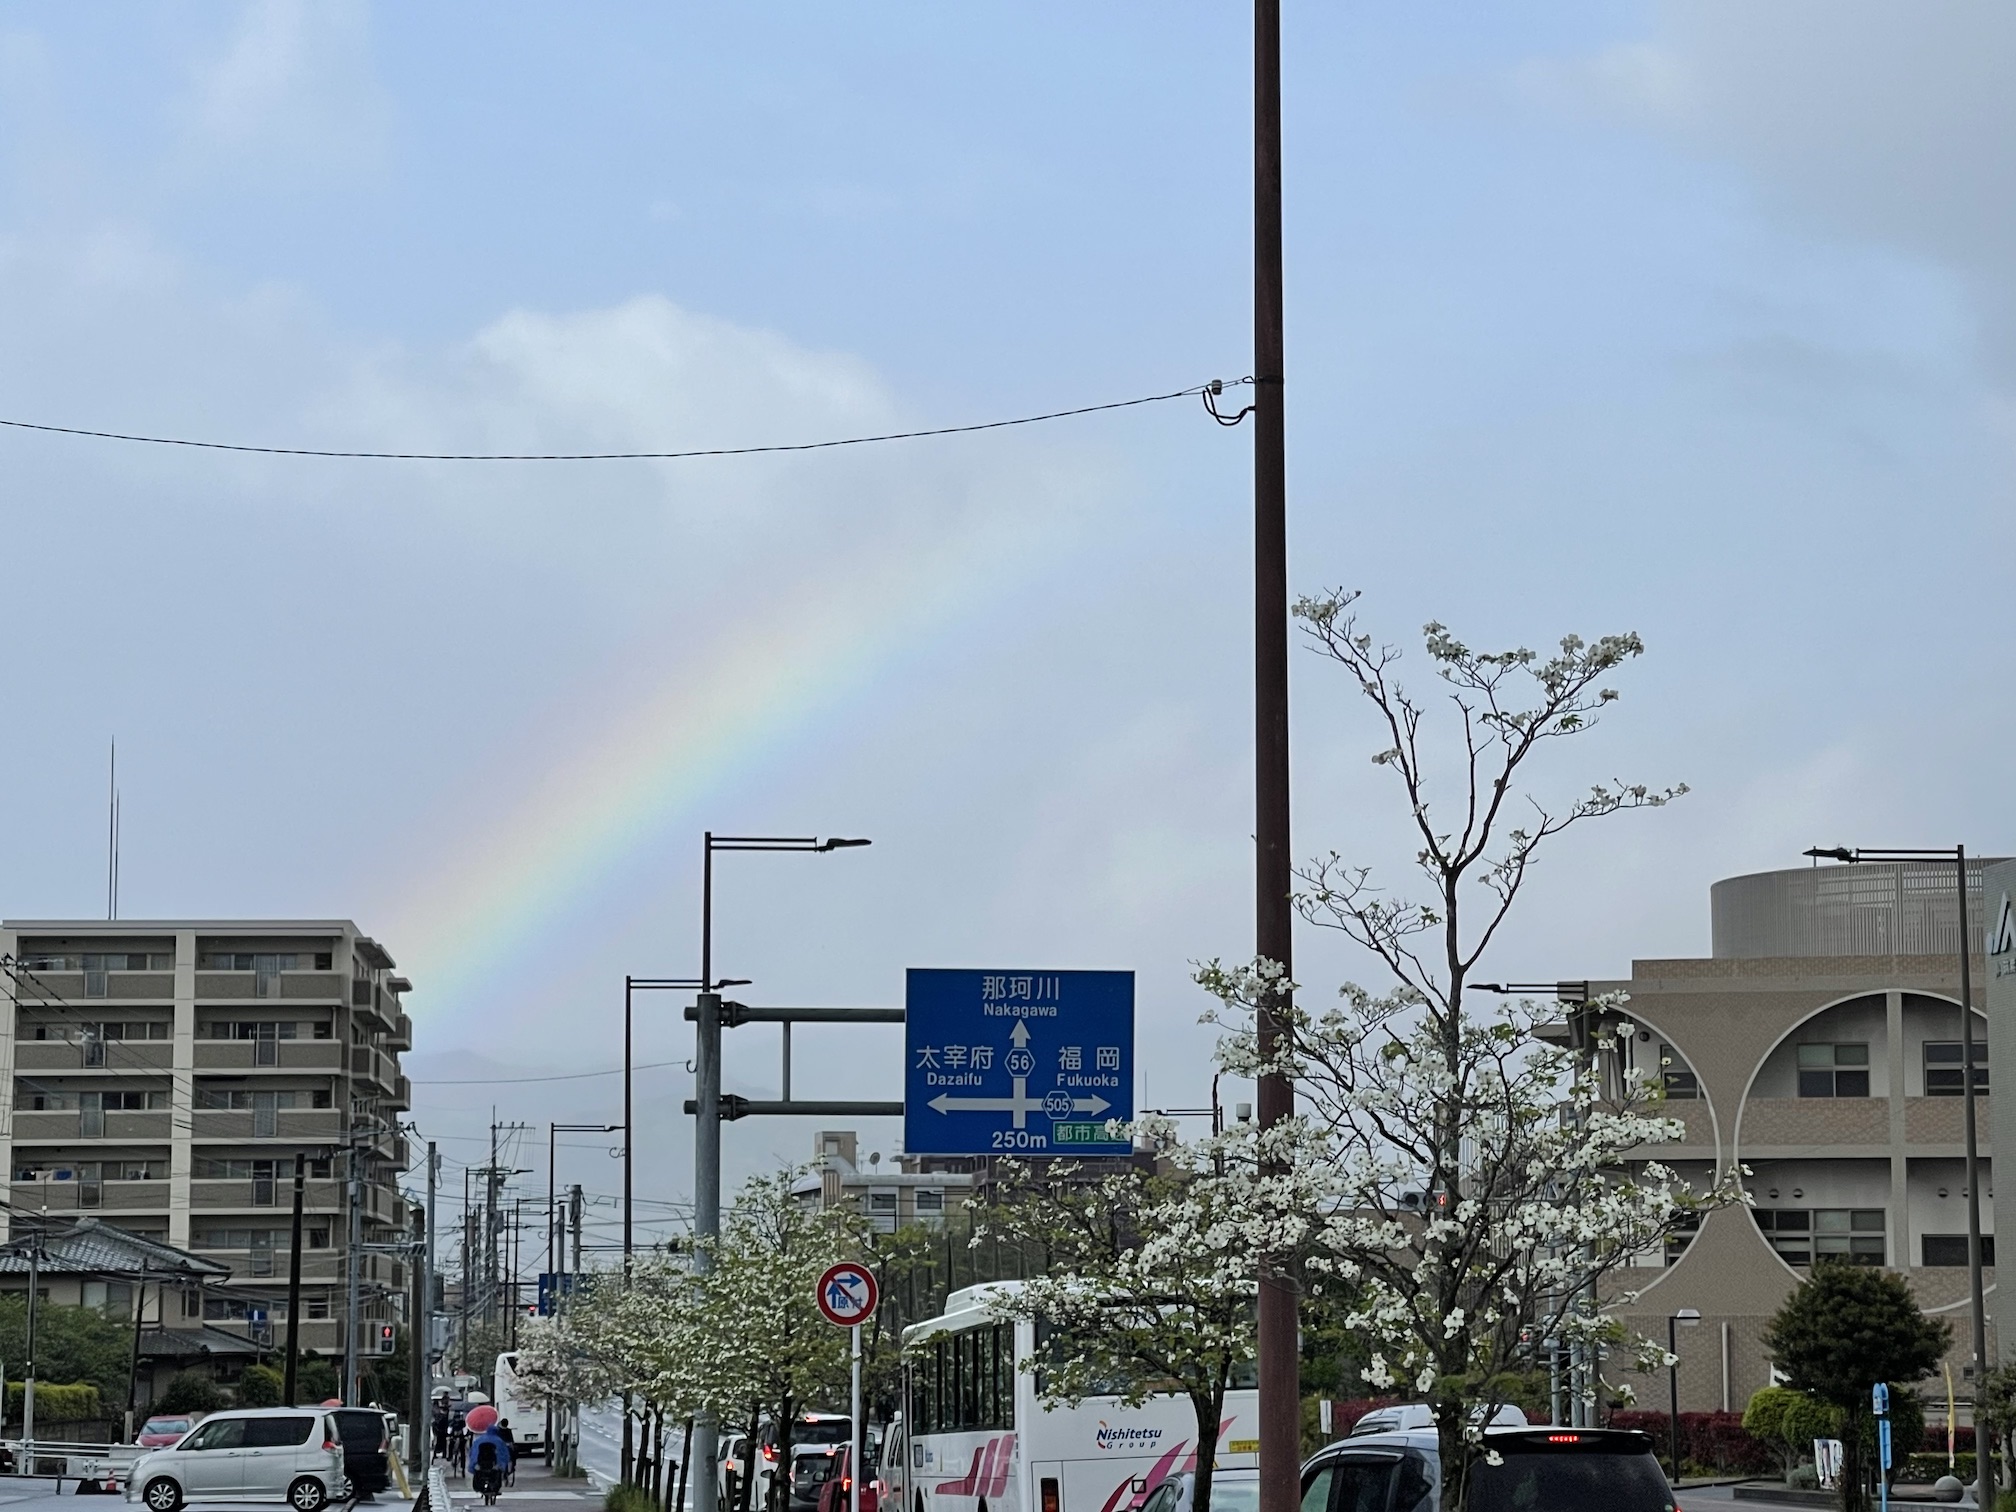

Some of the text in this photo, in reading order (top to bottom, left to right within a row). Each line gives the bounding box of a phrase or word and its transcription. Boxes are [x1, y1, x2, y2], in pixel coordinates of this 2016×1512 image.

[982, 976, 1060, 1000] 那珂川
[983, 1003, 1058, 1018] Nakagawa
[915, 1044, 994, 1070] 太宰府
[1010, 1055, 1030, 1071] 56
[1058, 1046, 1120, 1071] 福岡
[927, 1072, 983, 1086] Dazaifu
[1056, 1073, 1119, 1087] Fukuoka
[1046, 1098, 1070, 1112] 505
[992, 1131, 1047, 1149] 250m
[1096, 1428, 1162, 1441] Nishitetsu
[1106, 1440, 1157, 1450] Group
